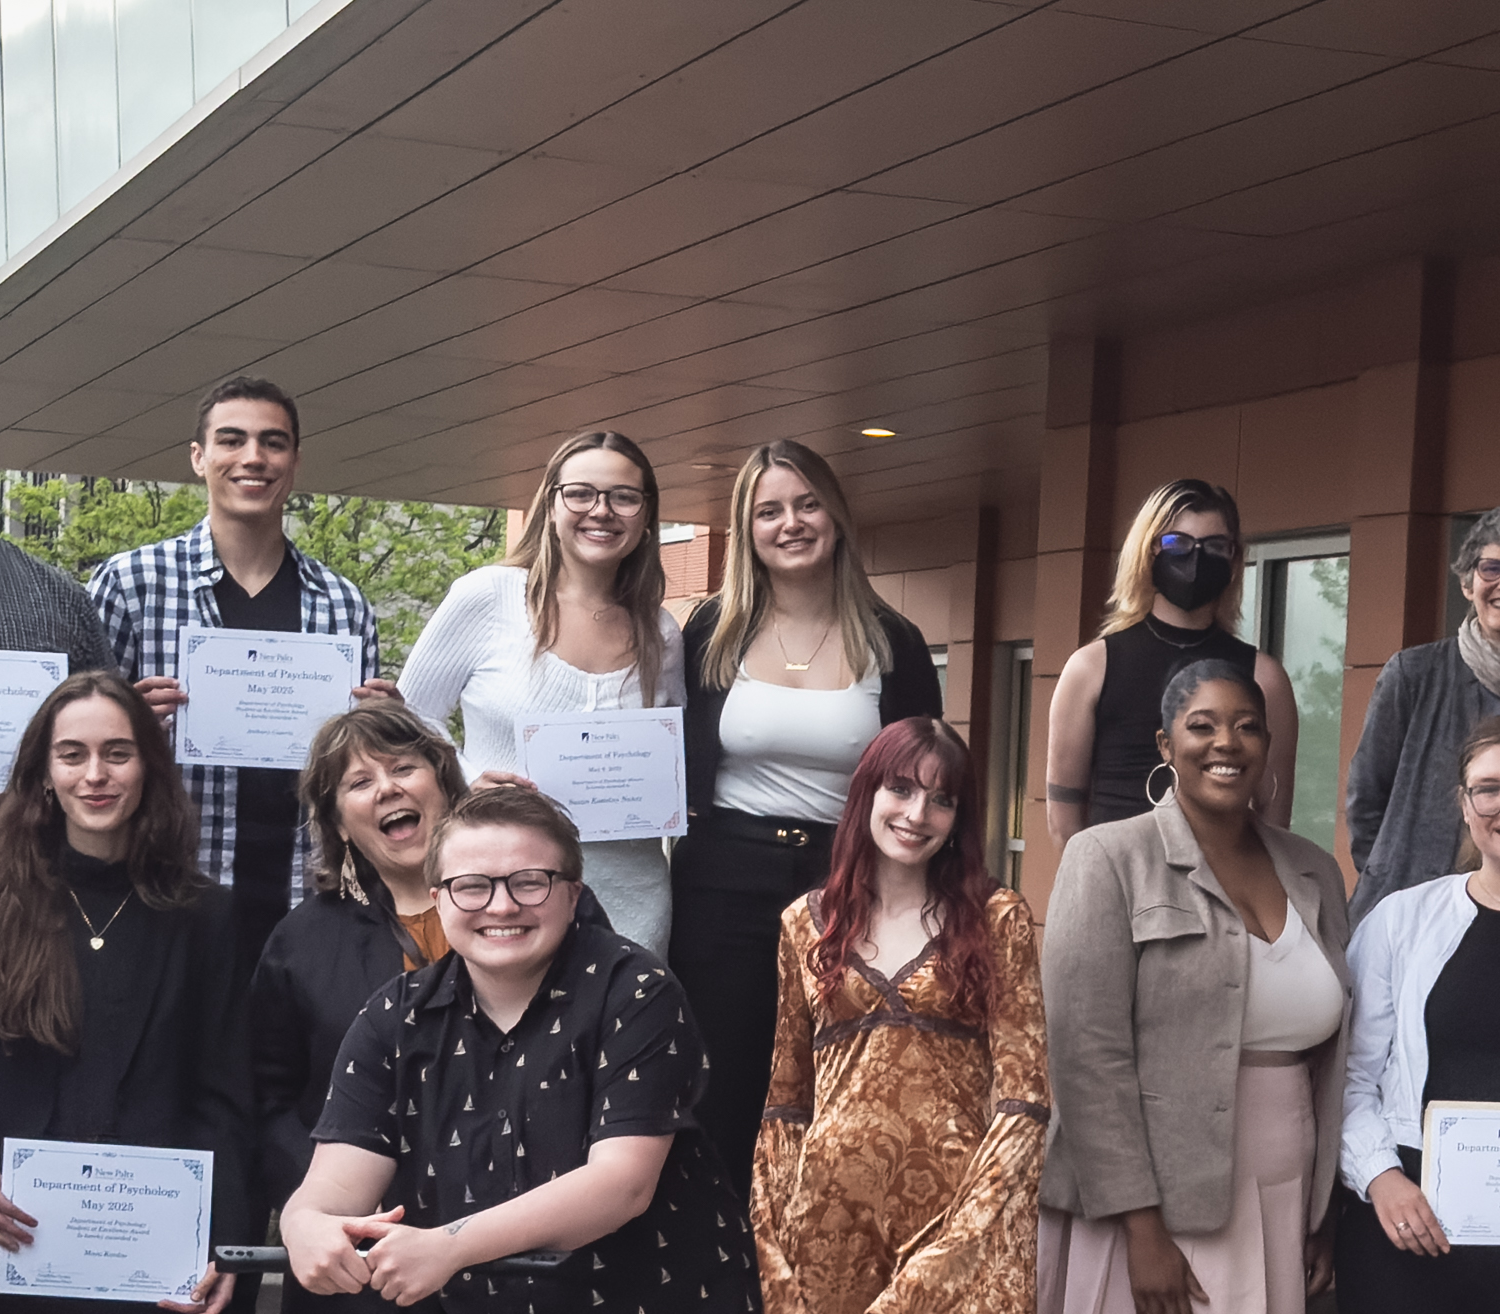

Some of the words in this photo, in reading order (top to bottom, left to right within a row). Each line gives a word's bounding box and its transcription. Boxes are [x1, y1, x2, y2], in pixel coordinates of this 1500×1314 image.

[205, 665, 264, 677] Department
[267, 668, 278, 677] of
[280, 669, 332, 682] Psychology
[247, 683, 266, 694] May
[270, 685, 294, 694] 2025
[95, 1167, 113, 1176] New
[32, 1177, 100, 1192] Department
[104, 1182, 117, 1192] of
[118, 1183, 180, 1198] Psychology
[81, 1199, 104, 1211] May
[107, 1201, 133, 1211] 2025
